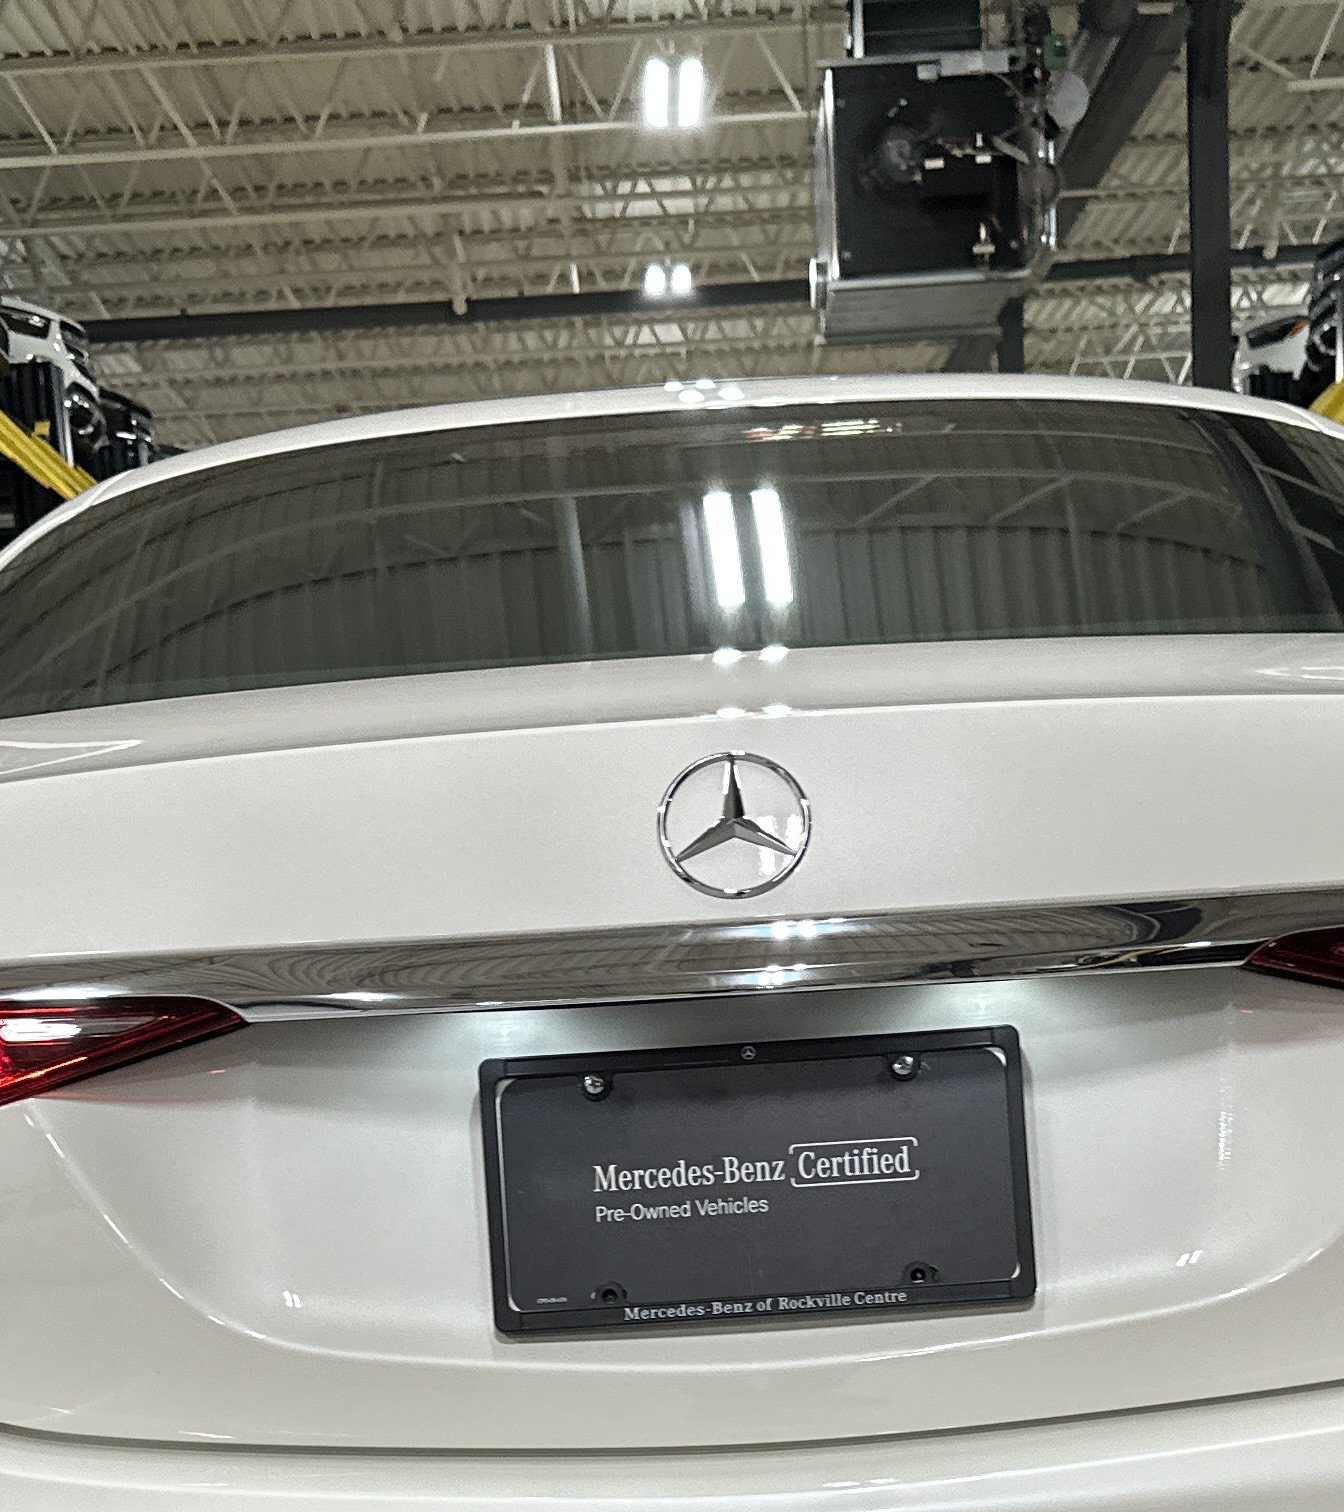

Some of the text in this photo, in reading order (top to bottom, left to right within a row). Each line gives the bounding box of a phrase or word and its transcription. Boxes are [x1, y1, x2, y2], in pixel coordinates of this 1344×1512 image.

[592, 1145, 911, 1193] Mercedes-Benz Certified
[595, 1196, 770, 1223] Pre-Owned Vehicles
[623, 1291, 908, 1320] Mercedes-Benz of Rockville Centre
